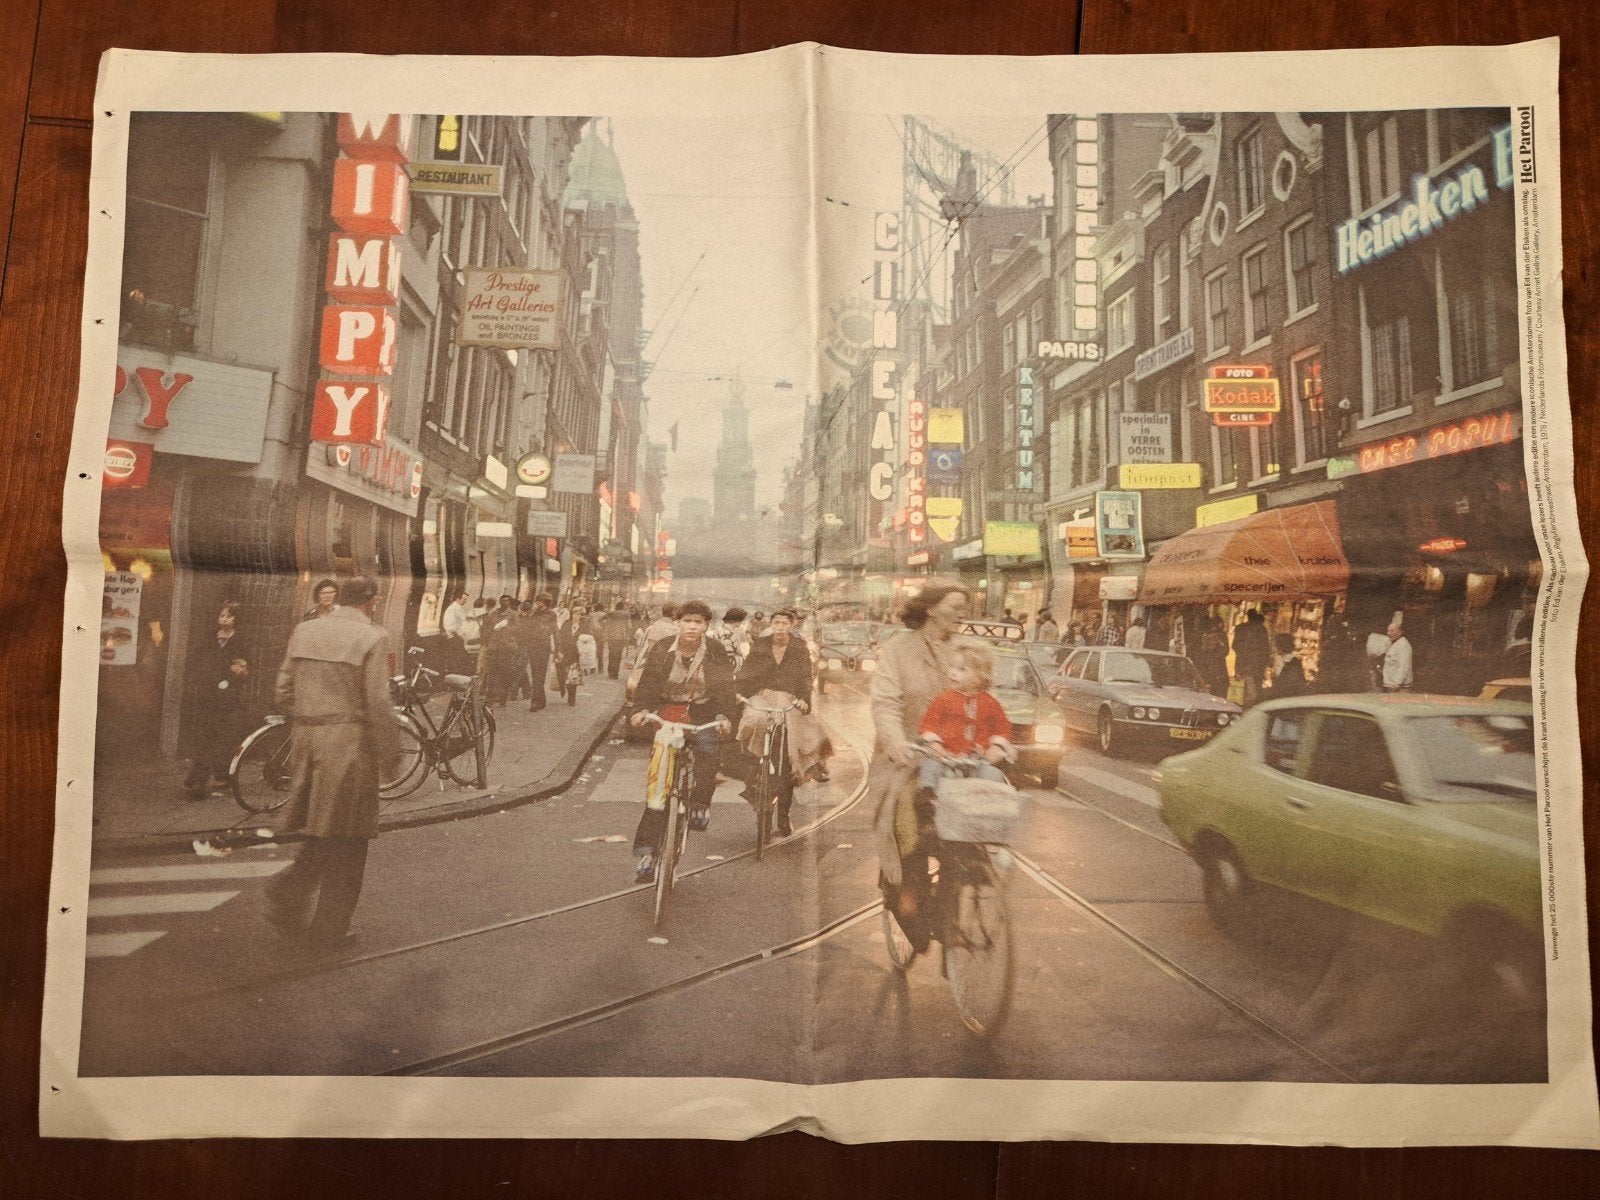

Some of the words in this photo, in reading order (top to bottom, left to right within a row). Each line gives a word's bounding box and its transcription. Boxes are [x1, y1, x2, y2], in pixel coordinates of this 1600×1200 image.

[1517, 106, 1531, 154] Parool
[417, 170, 493, 185] RESTAURANT
[1520, 158, 1533, 183] Het
[1530, 188, 1539, 228] Amsterdam
[1338, 168, 1488, 272] Heineken
[1521, 228, 1530, 250] Elsken
[325, 113, 390, 436] WIMPY
[1531, 256, 1540, 276] Gelink
[484, 273, 541, 296] Prestige
[1531, 277, 1541, 296] Annet
[467, 294, 494, 311] Art
[497, 295, 555, 313] Galleries
[1533, 298, 1545, 328] Courtesy
[495, 323, 540, 331] PAINTINGS
[498, 332, 539, 340] BRONZES
[1038, 341, 1098, 359] PARIS
[1524, 316, 1535, 365] Amsterdamse
[870, 212, 898, 500] CINEAC
[1535, 334, 1545, 379] Fotomuseum
[1226, 369, 1254, 378] FOTO
[1526, 366, 1536, 399] iconische
[1210, 386, 1275, 404] Kodak
[1536, 380, 1546, 419] Nederlands
[1122, 414, 1168, 426] specialist
[1230, 413, 1255, 422] CINE
[1528, 401, 1537, 424] andere
[1018, 367, 1033, 489] KELTUM
[1140, 425, 1150, 434] in
[1131, 435, 1160, 445] VERRE
[1529, 440, 1539, 459] editie
[1128, 446, 1165, 456] OOSTEN
[1533, 484, 1543, 501] heeft
[1540, 524, 1550, 540] onze
[1544, 541, 1555, 555] voor
[1244, 556, 1271, 565] thee
[1547, 557, 1557, 581] cadeau
[1223, 582, 1285, 593] specerijen
[960, 624, 1008, 638] AXI
[1537, 620, 1548, 667] verschillende
[1537, 690, 1549, 720] vandaag
[1539, 722, 1548, 740] krant
[1540, 752, 1552, 788] verschijnt
[1542, 789, 1552, 812] Parool
[1547, 843, 1555, 873] nummer
[1549, 928, 1560, 960] Vanwege
